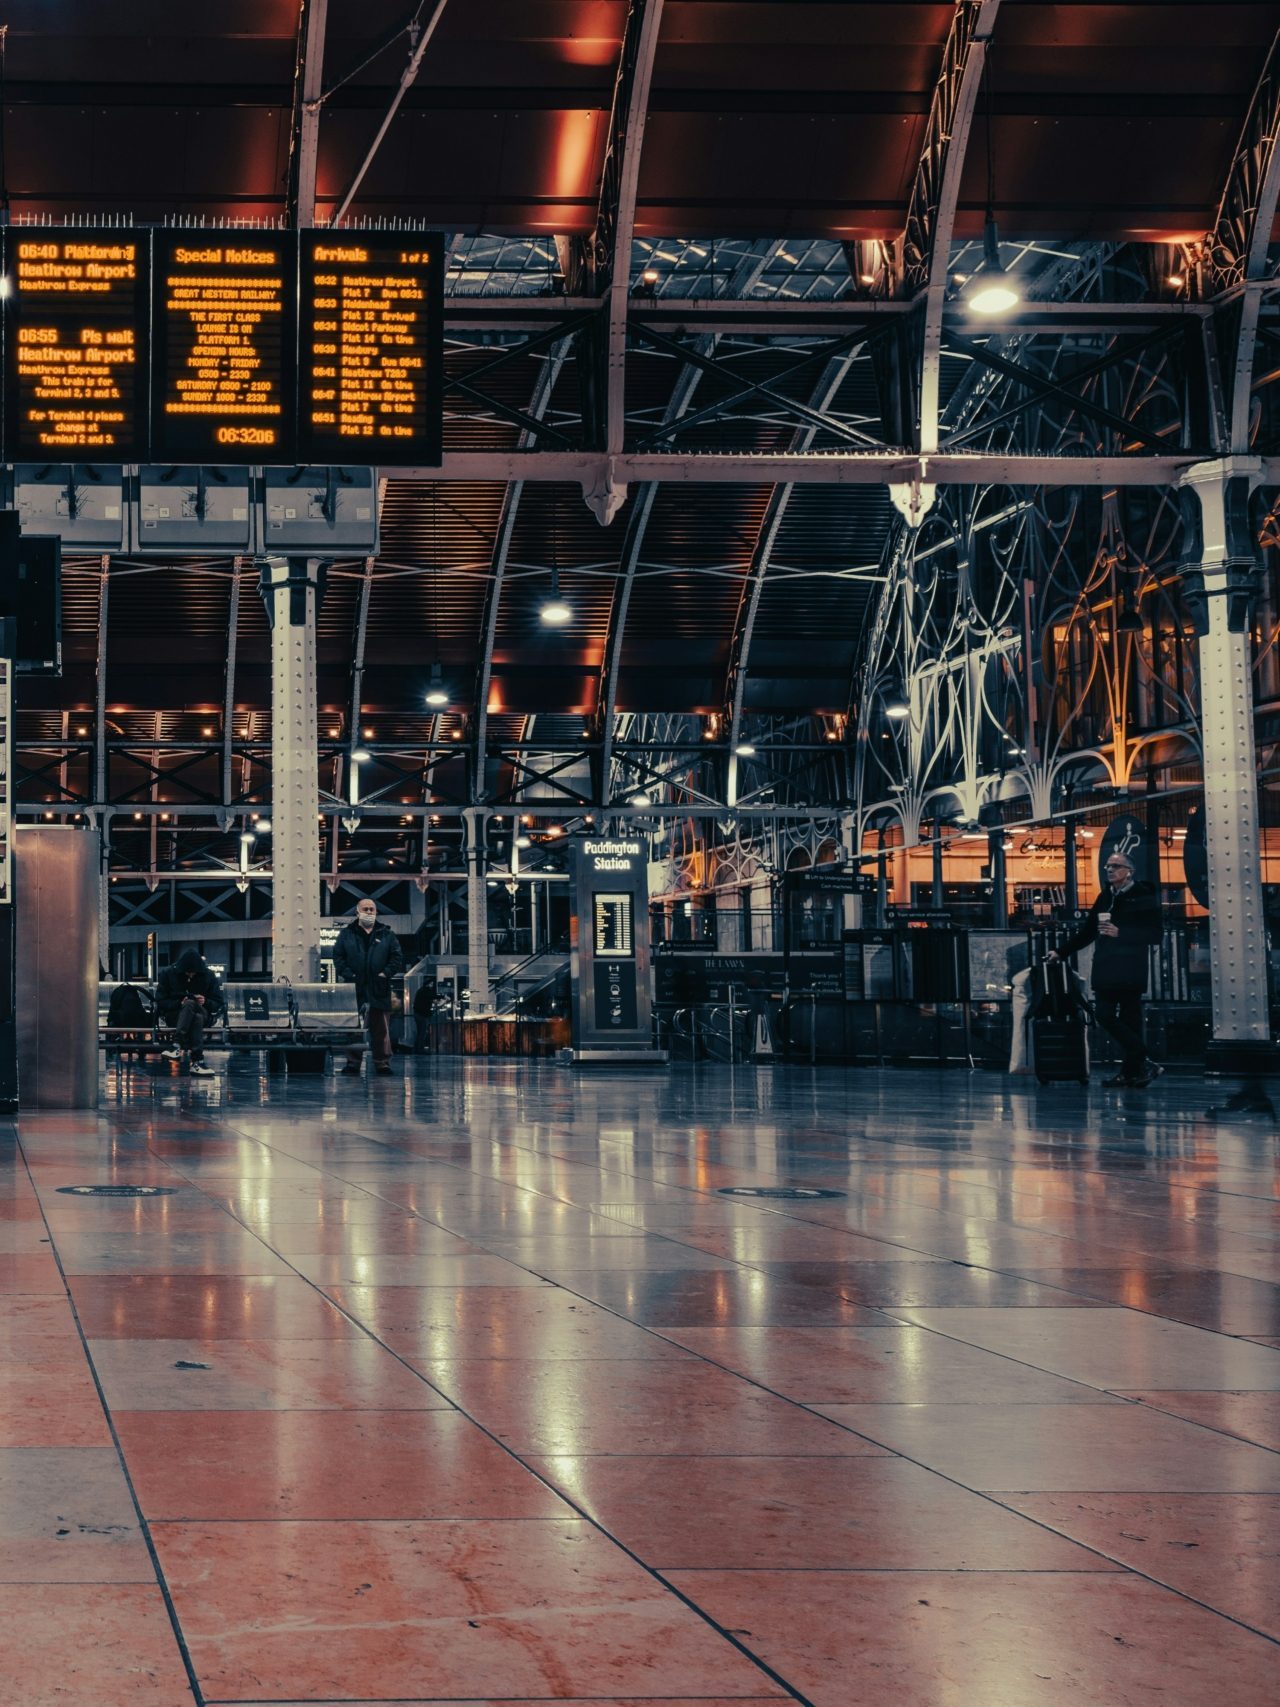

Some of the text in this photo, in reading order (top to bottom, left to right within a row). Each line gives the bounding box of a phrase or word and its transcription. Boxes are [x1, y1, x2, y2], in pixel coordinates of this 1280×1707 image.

[18, 243, 59, 260] 06:40
[175, 248, 276, 264] Special Notices
[314, 246, 368, 262] Arrivals
[18, 262, 136, 280] Heathrow Airport
[18, 328, 135, 345] 06:55 Pls wait
[17, 346, 135, 364] Heathrow Airport
[584, 841, 639, 855] Paddington
[594, 857, 630, 870] Station
